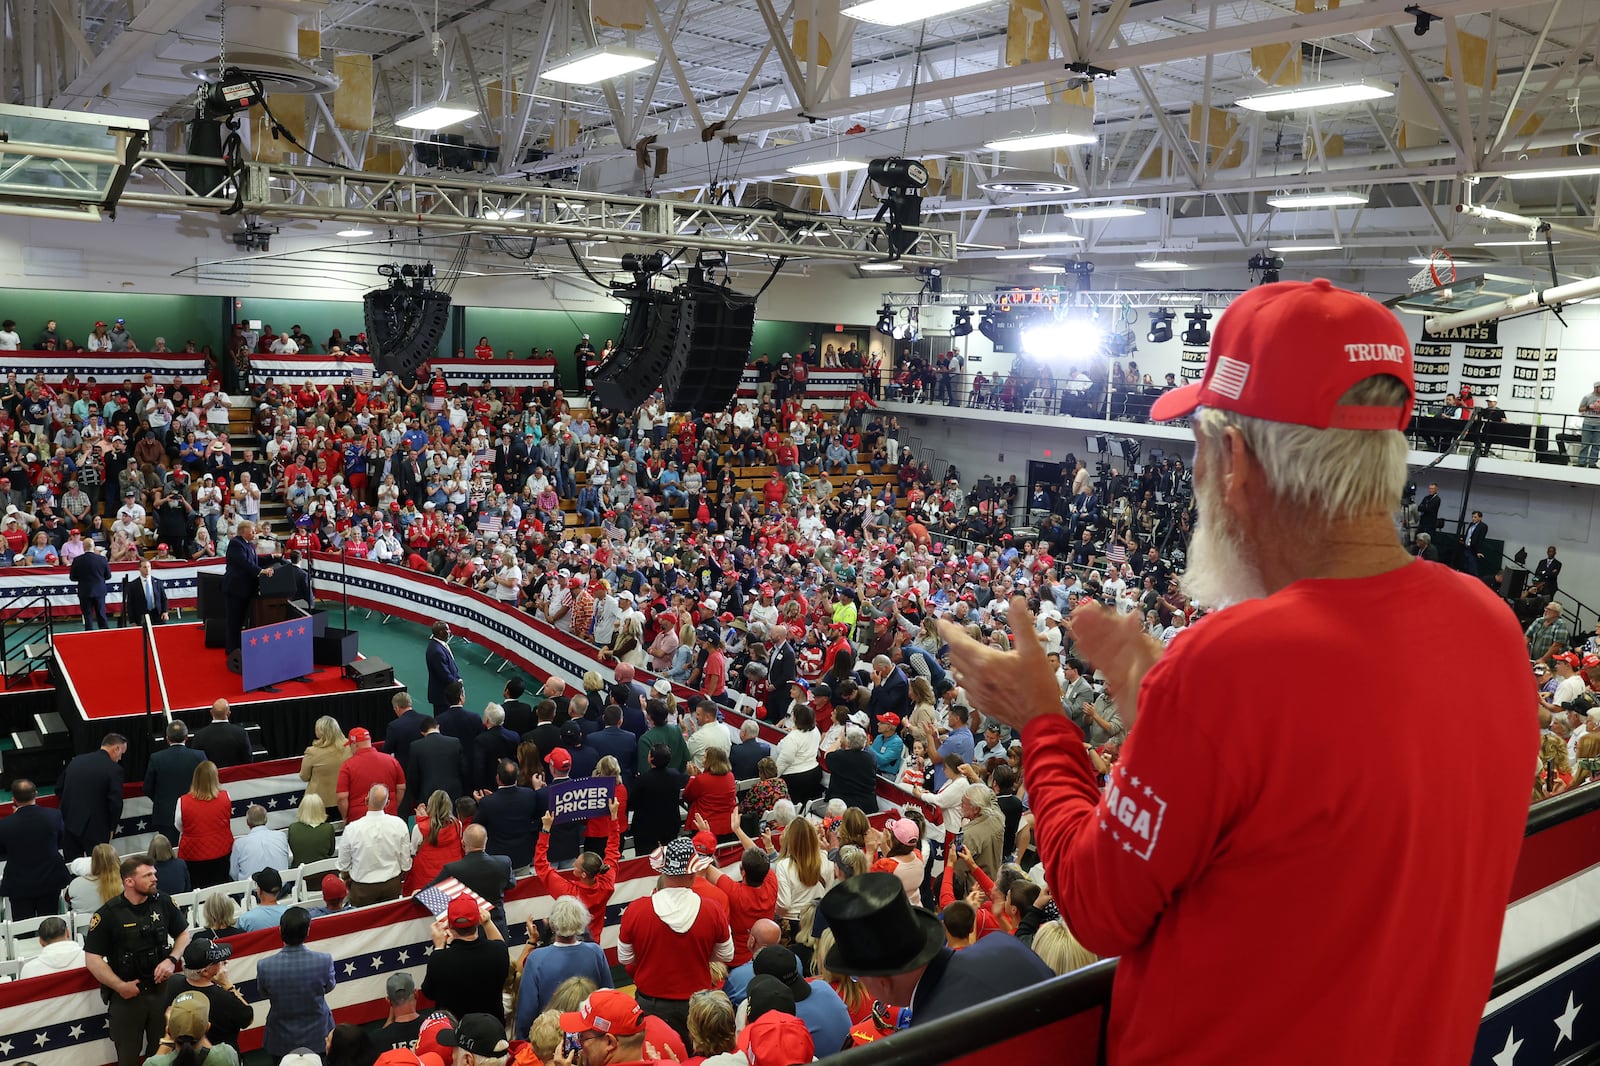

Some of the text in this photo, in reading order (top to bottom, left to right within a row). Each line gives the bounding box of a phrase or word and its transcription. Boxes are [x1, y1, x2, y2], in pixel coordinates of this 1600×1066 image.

[1431, 327, 1489, 340] CHAMPS
[1344, 343, 1406, 364] TRUMP
[1414, 382, 1447, 392] 985-86
[555, 787, 608, 806] LOWER
[555, 798, 607, 816] PRICES
[1105, 778, 1151, 841] AGA
